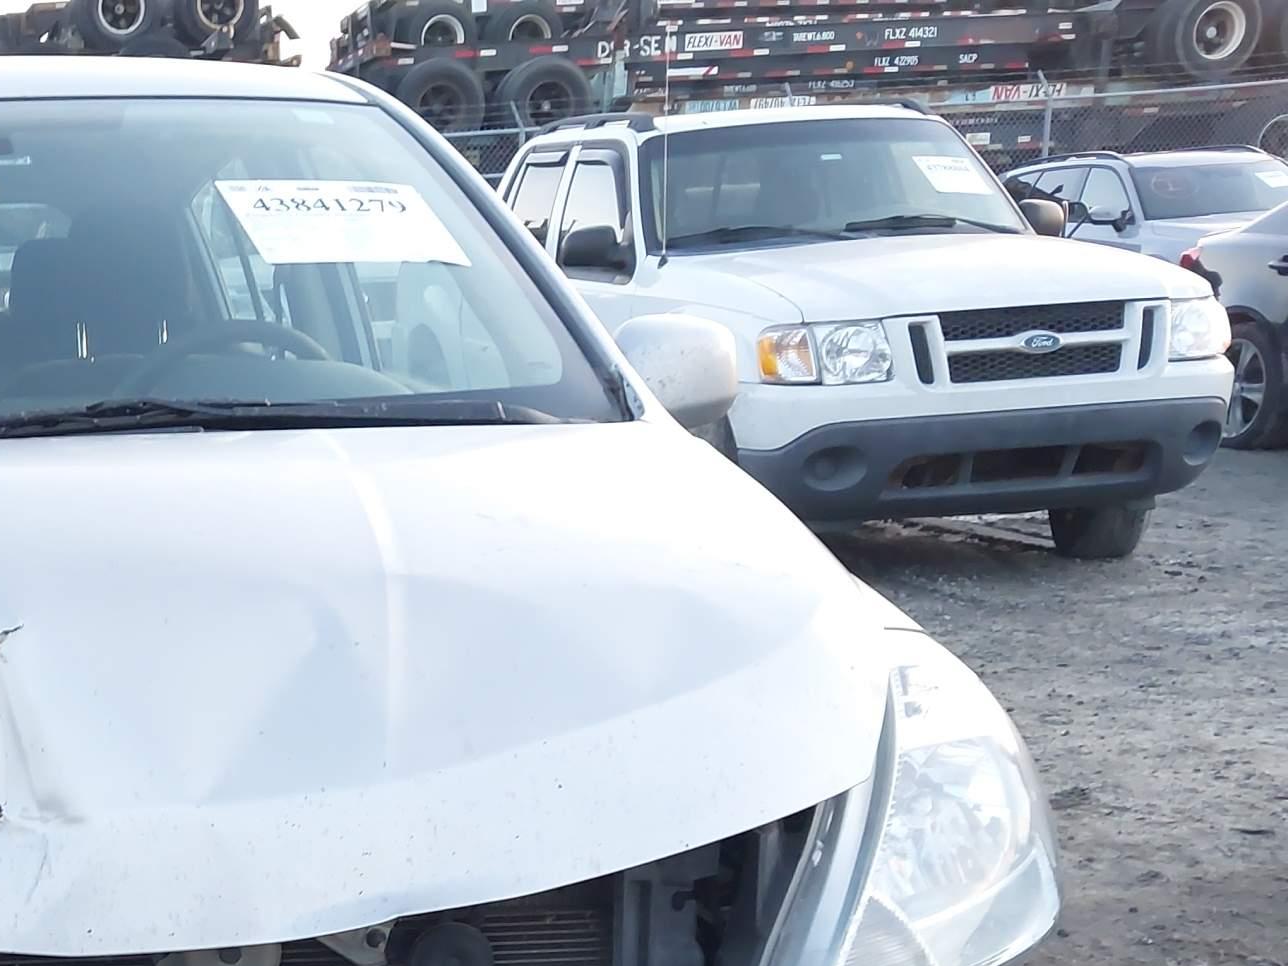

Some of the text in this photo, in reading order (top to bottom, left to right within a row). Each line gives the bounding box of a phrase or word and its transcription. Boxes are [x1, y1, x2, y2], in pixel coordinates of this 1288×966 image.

[884, 26, 938, 40] FLXZ 414321
[686, 33, 741, 49] FLEXI-VAN
[252, 197, 407, 214] 43841279
[1031, 336, 1055, 348] Ford
